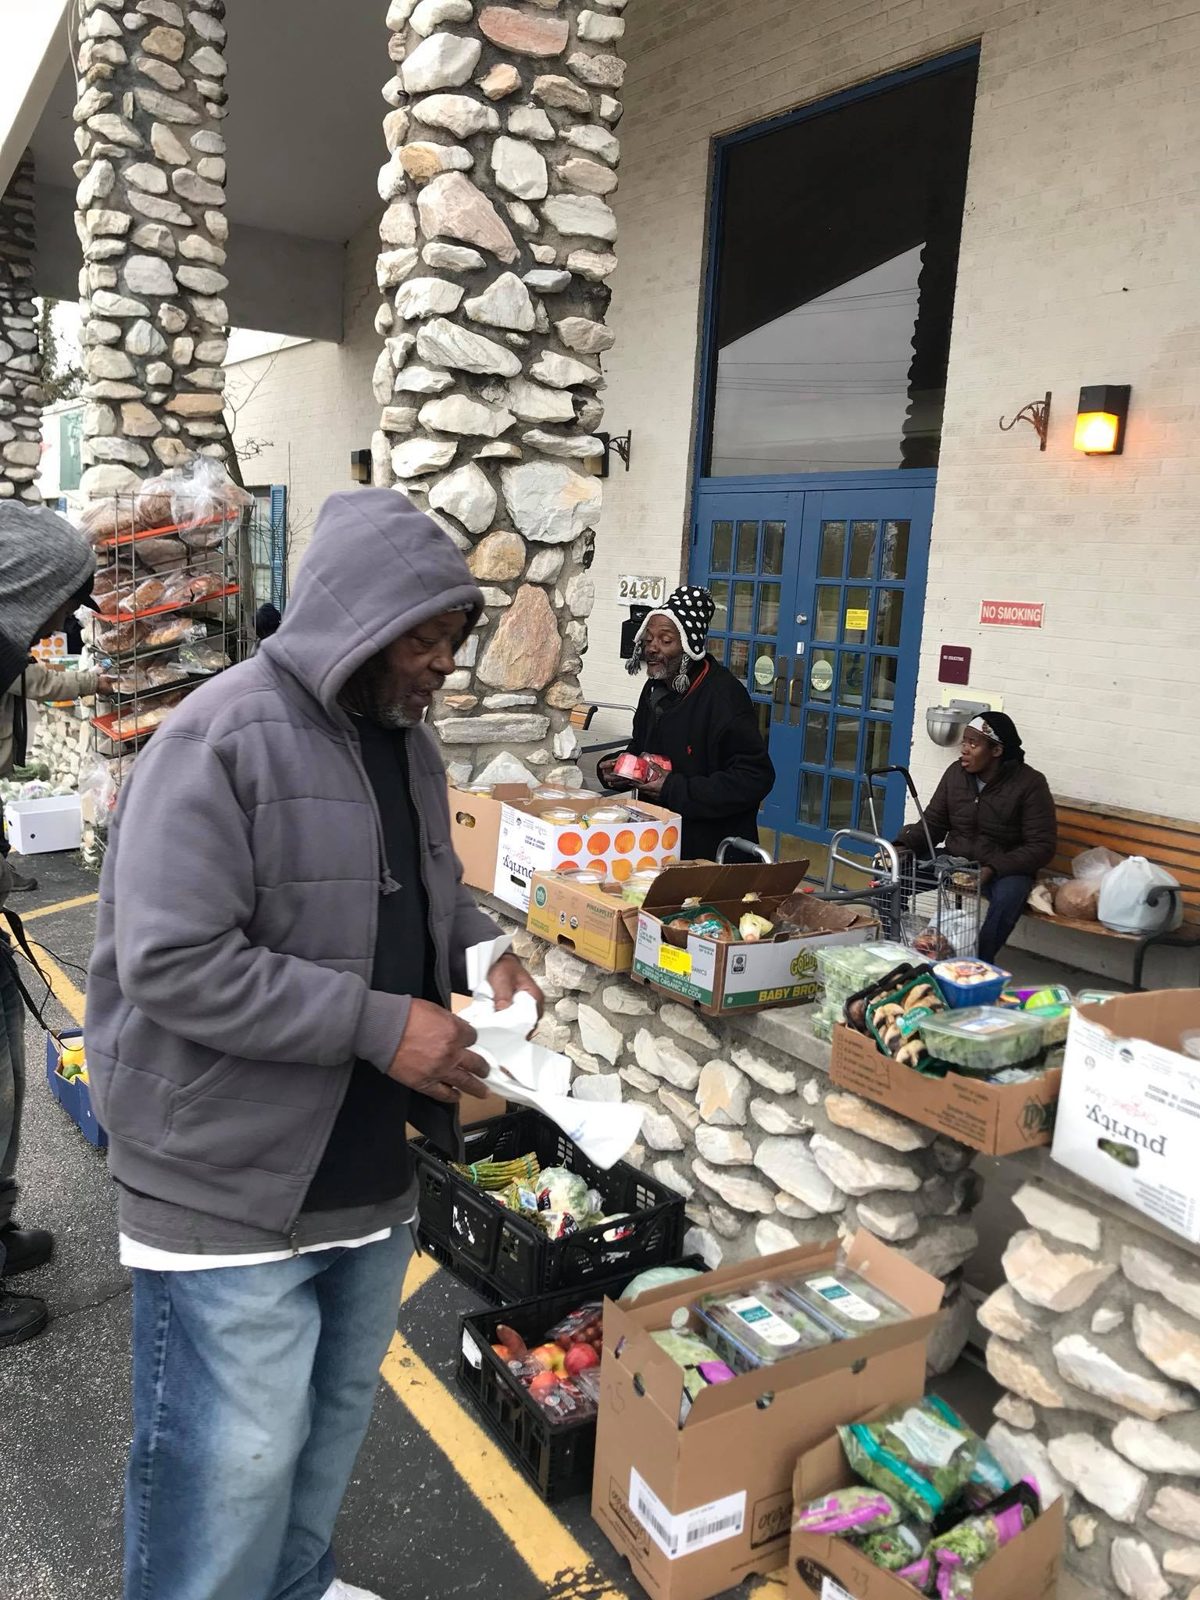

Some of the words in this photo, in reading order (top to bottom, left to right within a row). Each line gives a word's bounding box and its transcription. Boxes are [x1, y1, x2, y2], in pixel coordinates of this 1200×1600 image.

[620, 580, 661, 600] 2420
[982, 605, 996, 619] NO
[997, 606, 1041, 622] SMOKING
[660, 978, 681, 992] ORGANIC
[758, 986, 791, 1002] BABY
[1085, 1104, 1168, 1157] purity.
